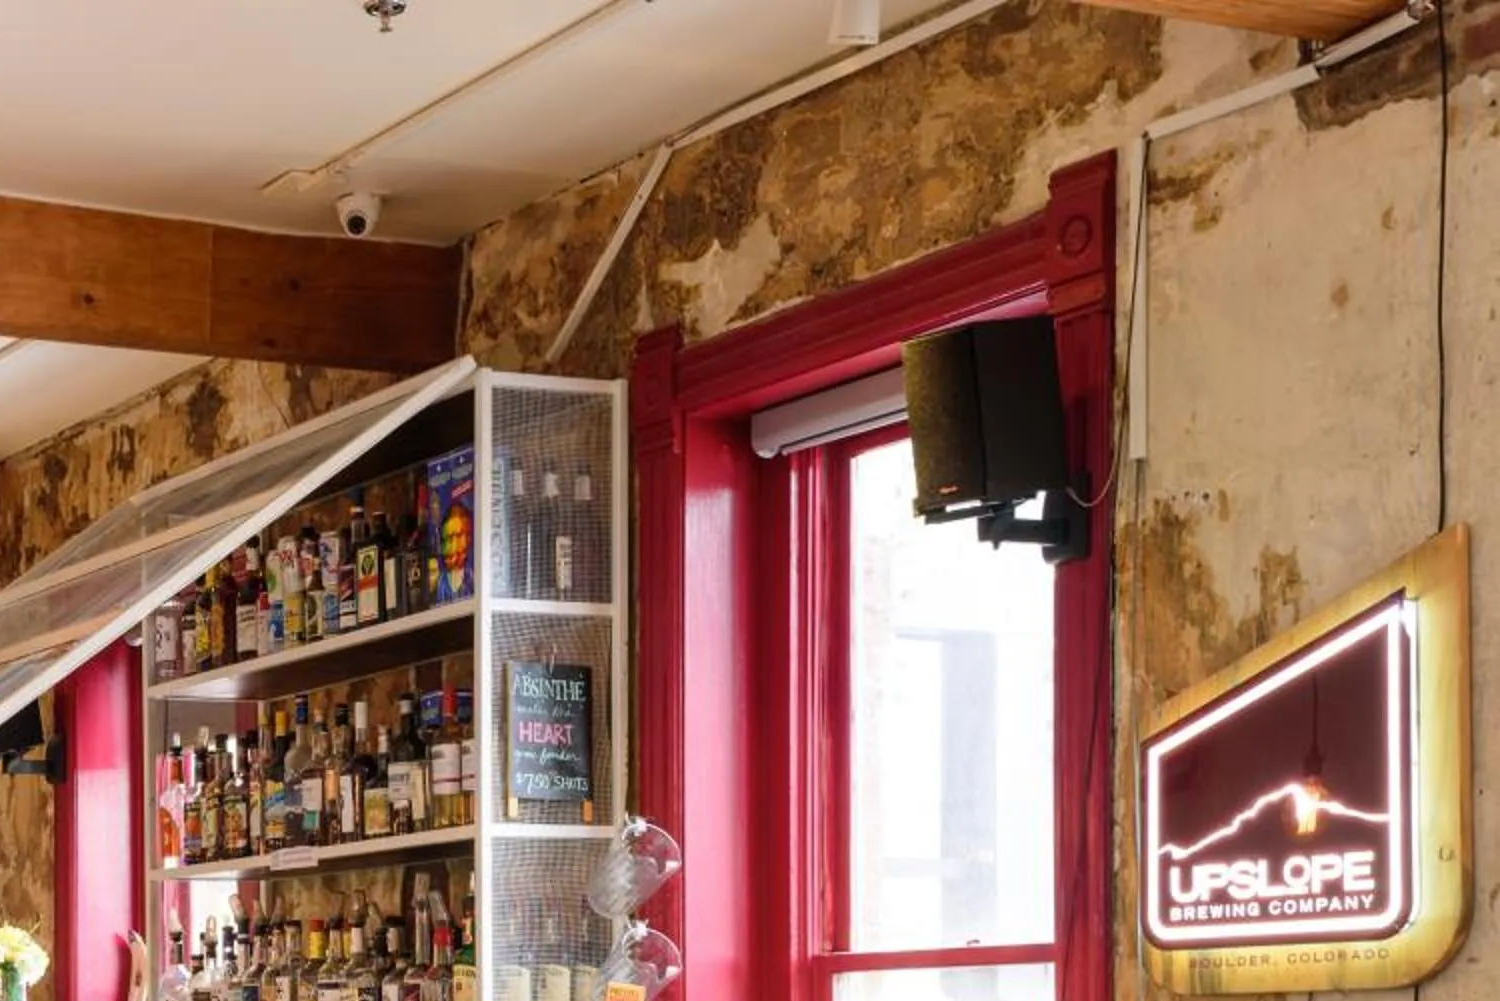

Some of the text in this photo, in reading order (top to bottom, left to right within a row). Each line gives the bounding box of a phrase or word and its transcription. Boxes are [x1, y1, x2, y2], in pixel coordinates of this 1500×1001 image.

[513, 672, 586, 701] ABSINTHE
[519, 720, 574, 744] HEART
[1170, 850, 1375, 903] UPSLOPE
[1169, 895, 1375, 922] BREWING COMPANY
[1287, 948, 1389, 964] COLORADO
